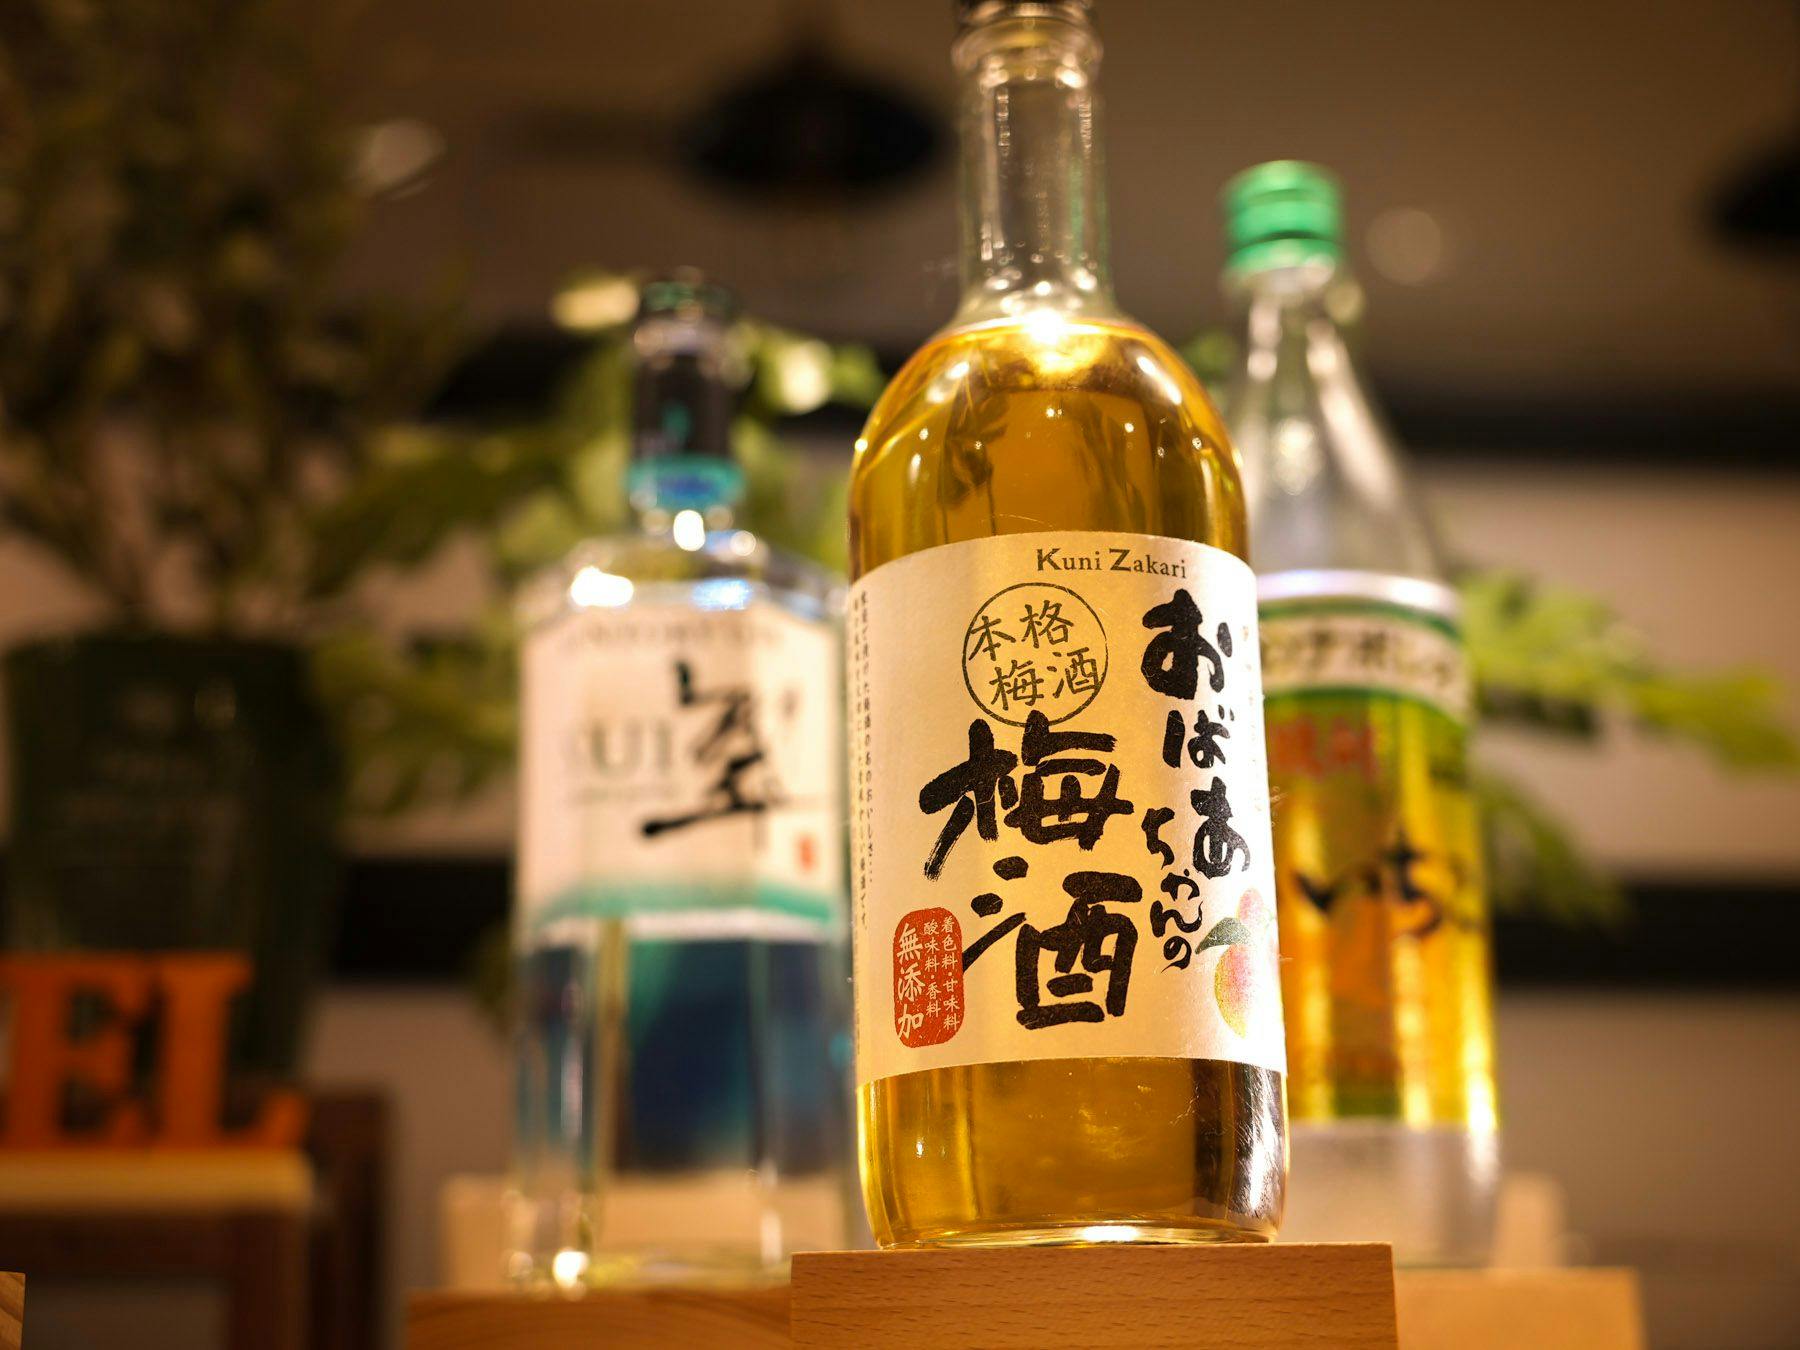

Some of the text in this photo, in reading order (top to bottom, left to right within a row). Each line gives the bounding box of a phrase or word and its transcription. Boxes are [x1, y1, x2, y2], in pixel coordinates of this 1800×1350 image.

[1036, 548, 1187, 579] Kuni Zakari
[968, 599, 1075, 662] 本格
[988, 646, 1100, 711] 梅酒
[919, 710, 1143, 1030] 梅酒
[896, 922, 926, 1040] 無添加
[923, 918, 941, 1018] 酸味料・香料
[941, 915, 960, 1031] 着色料・甘味料
